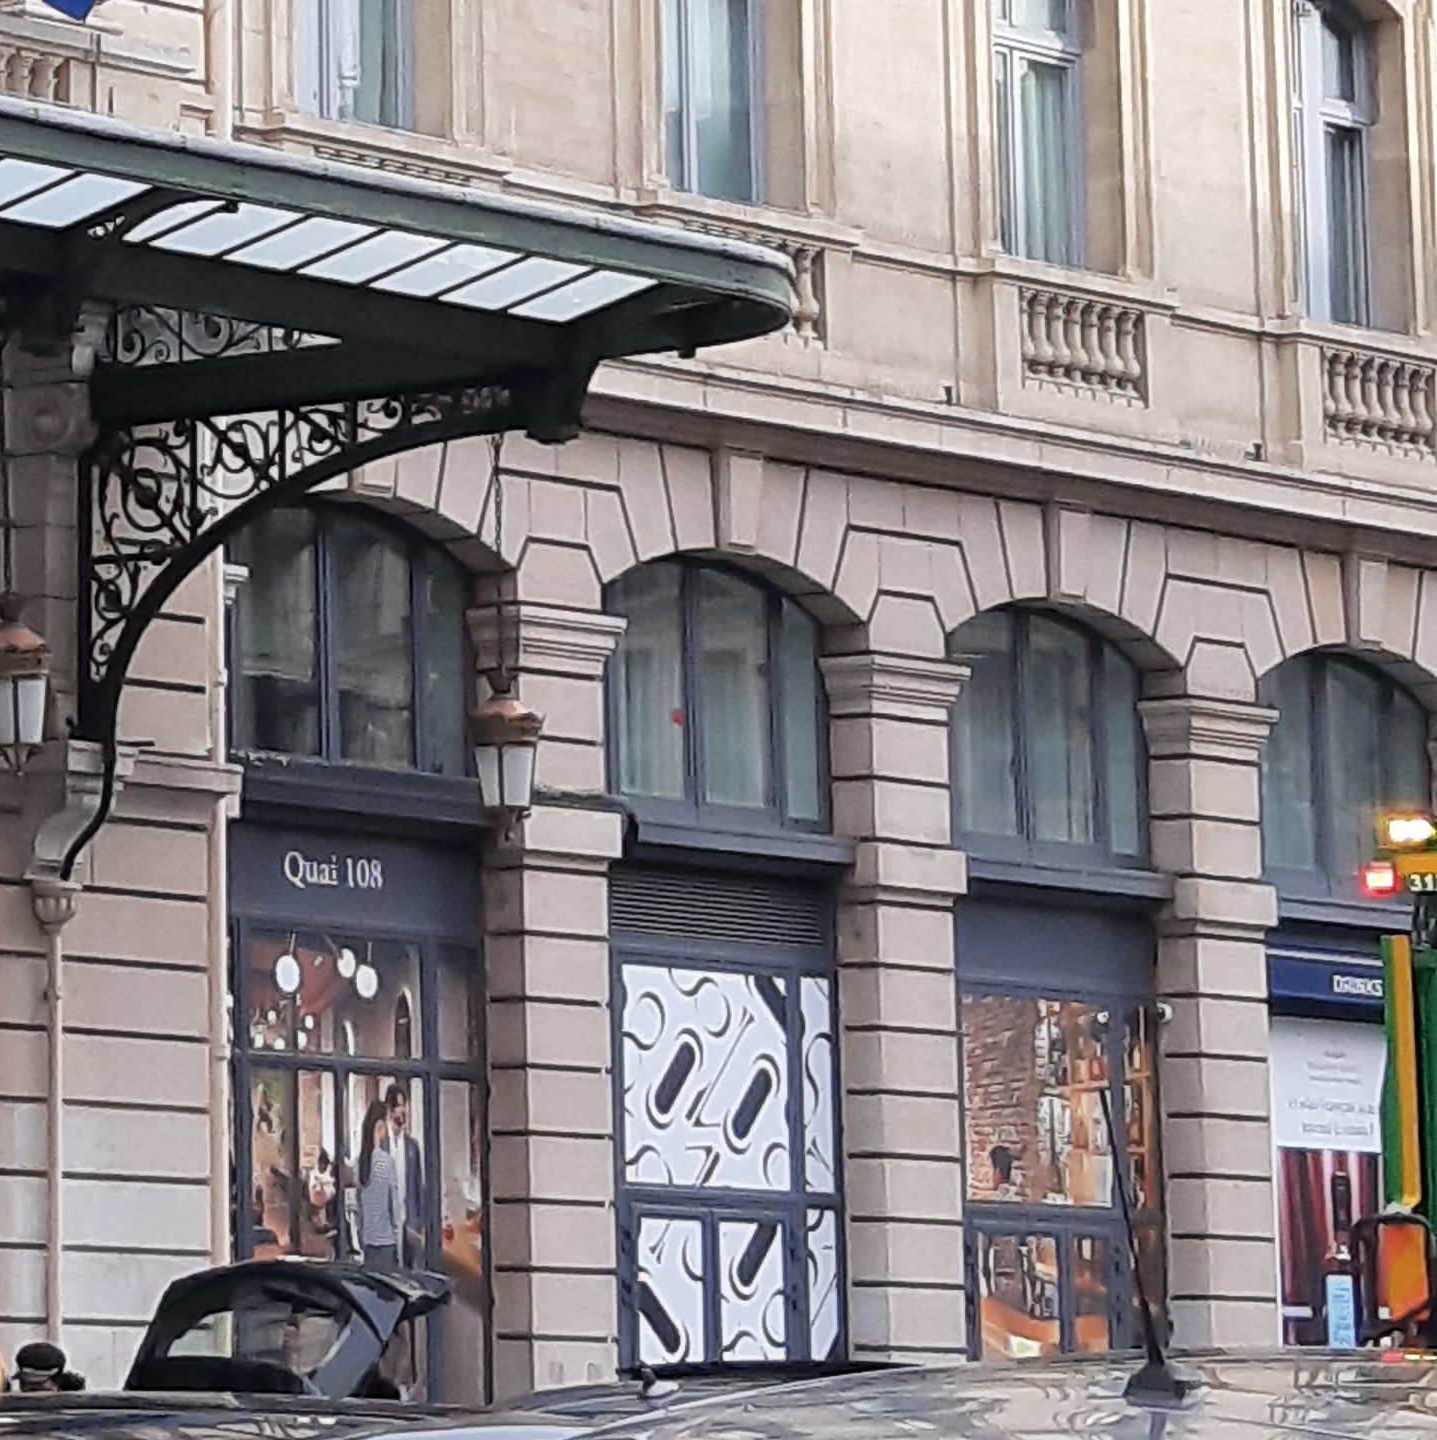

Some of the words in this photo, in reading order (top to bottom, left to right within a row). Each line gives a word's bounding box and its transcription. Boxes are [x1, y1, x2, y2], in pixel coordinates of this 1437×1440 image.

[284, 850, 339, 889] Quai
[345, 857, 383, 889] 108
[1409, 872, 1437, 892] 31
